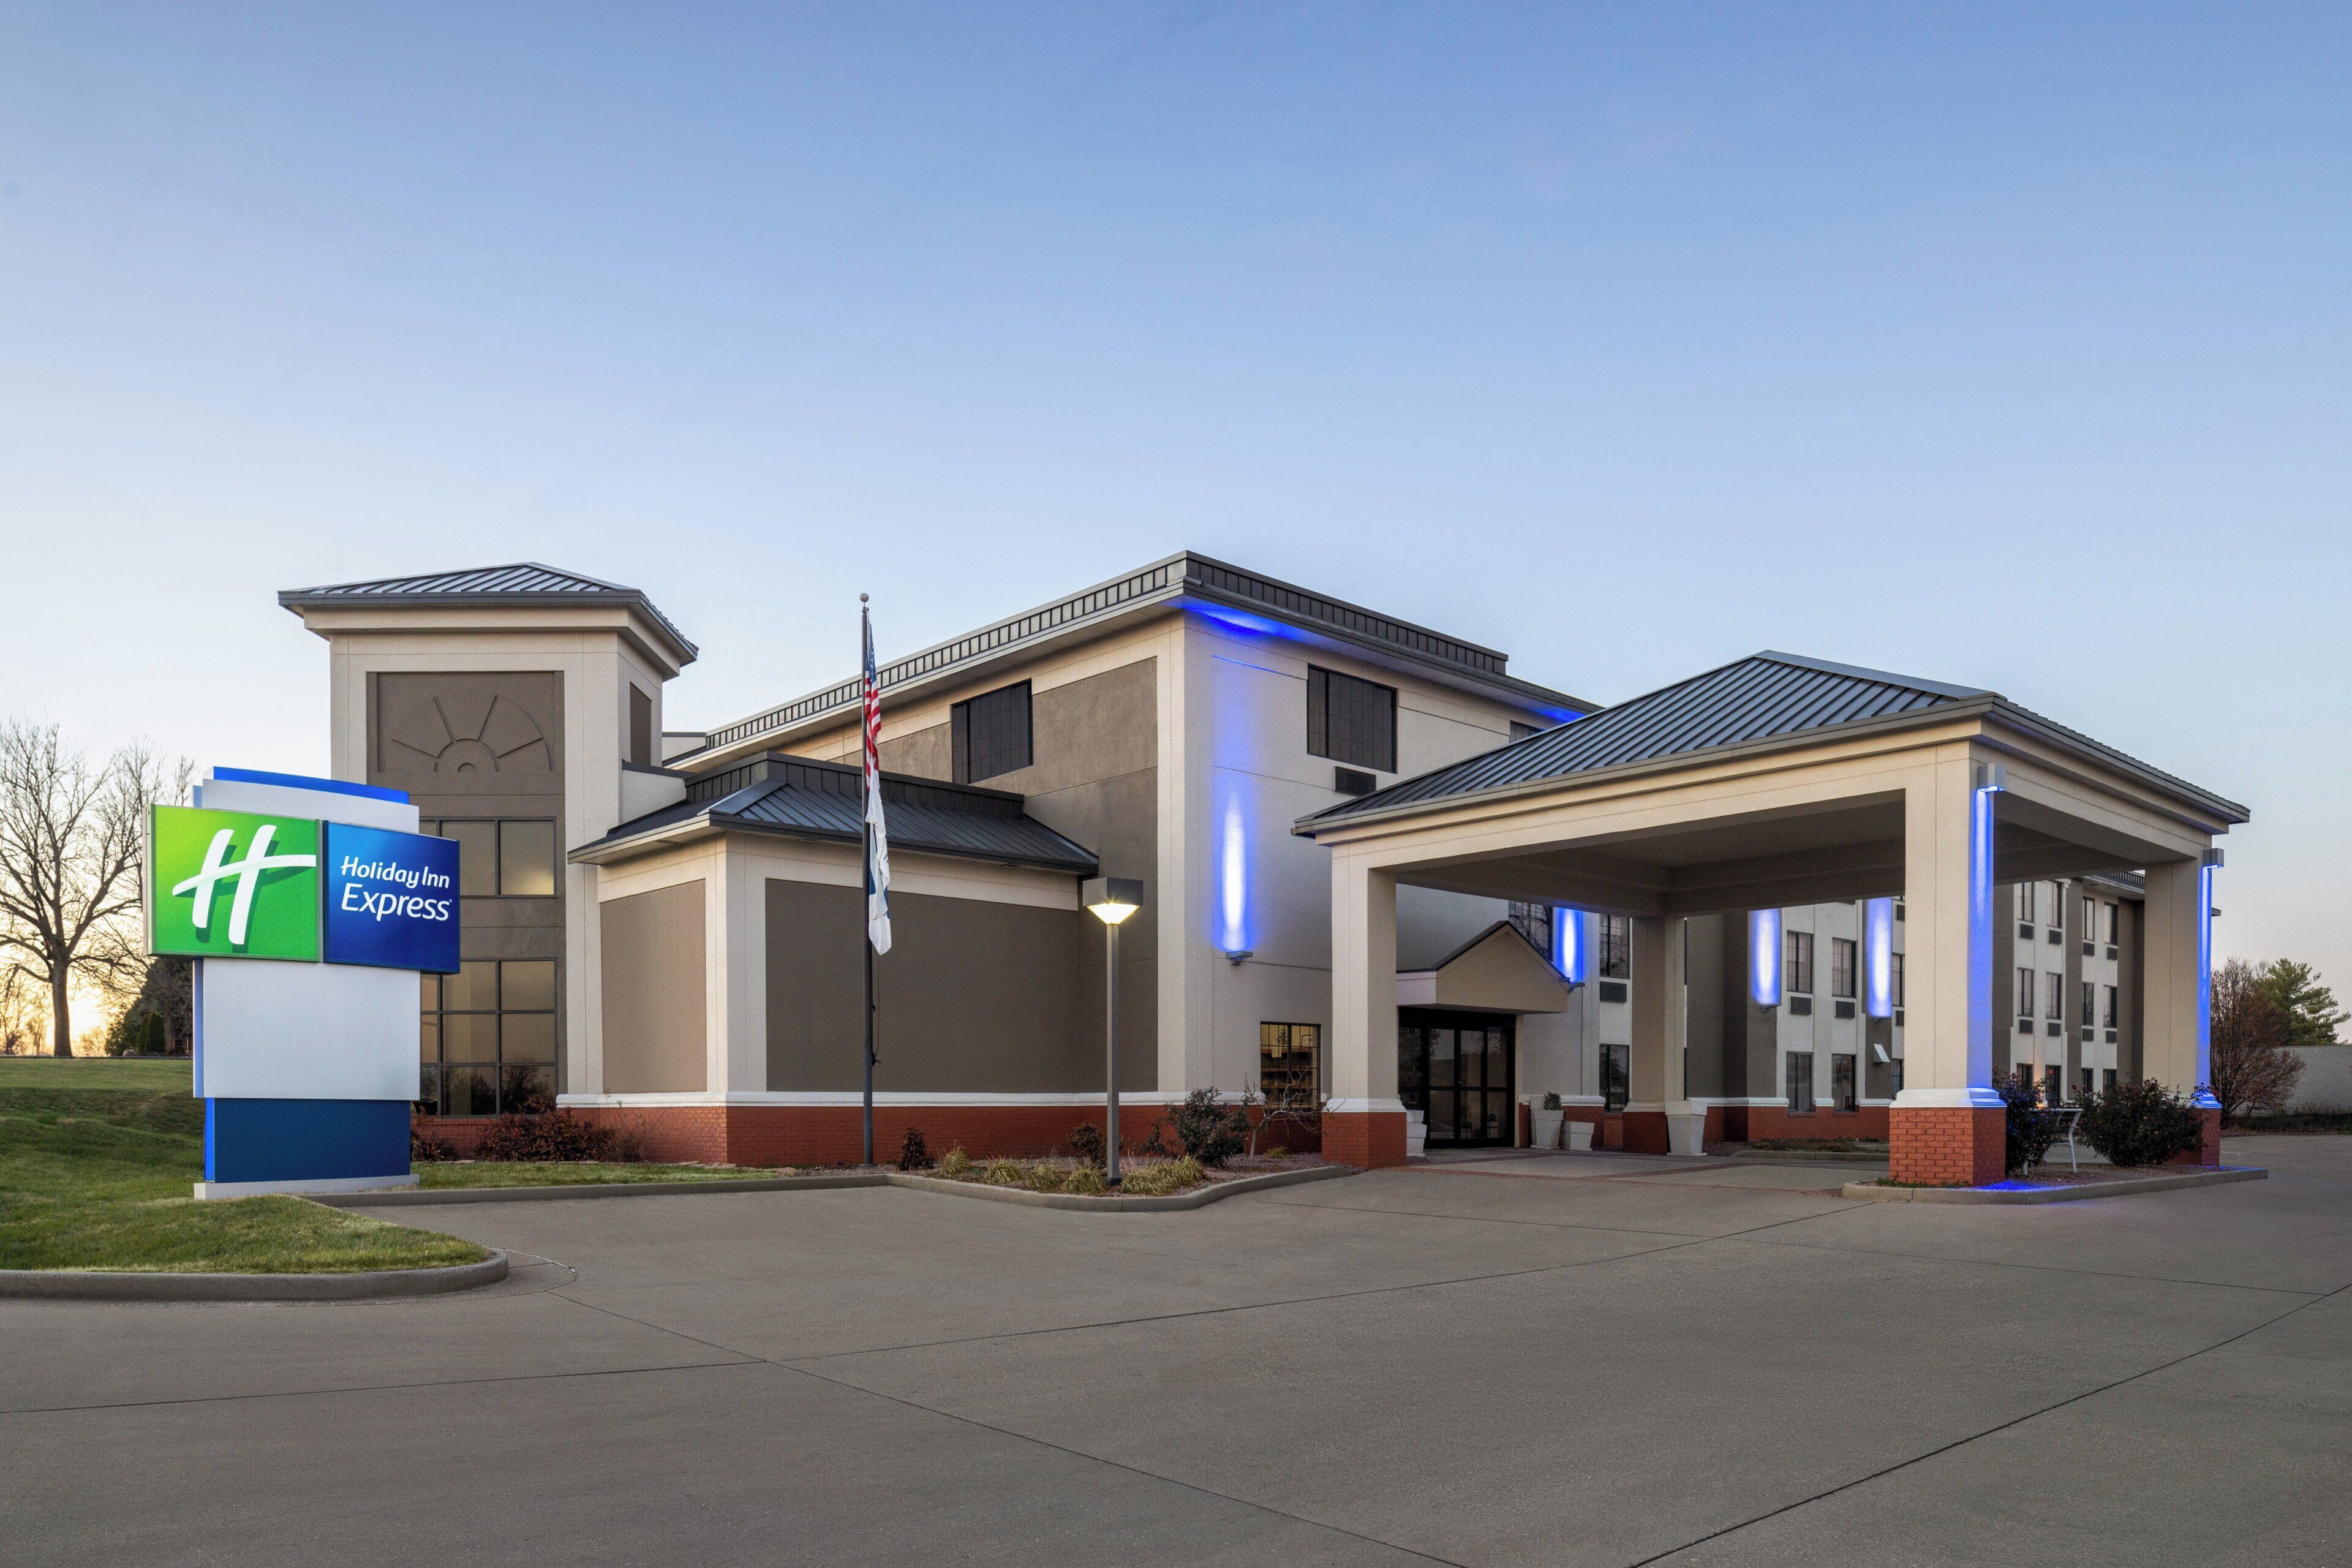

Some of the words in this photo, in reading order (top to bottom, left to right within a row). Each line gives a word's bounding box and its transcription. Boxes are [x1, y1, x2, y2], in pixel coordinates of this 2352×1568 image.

[341, 856, 420, 889] Holiday
[421, 866, 450, 889] Inn
[341, 883, 450, 921] Express
